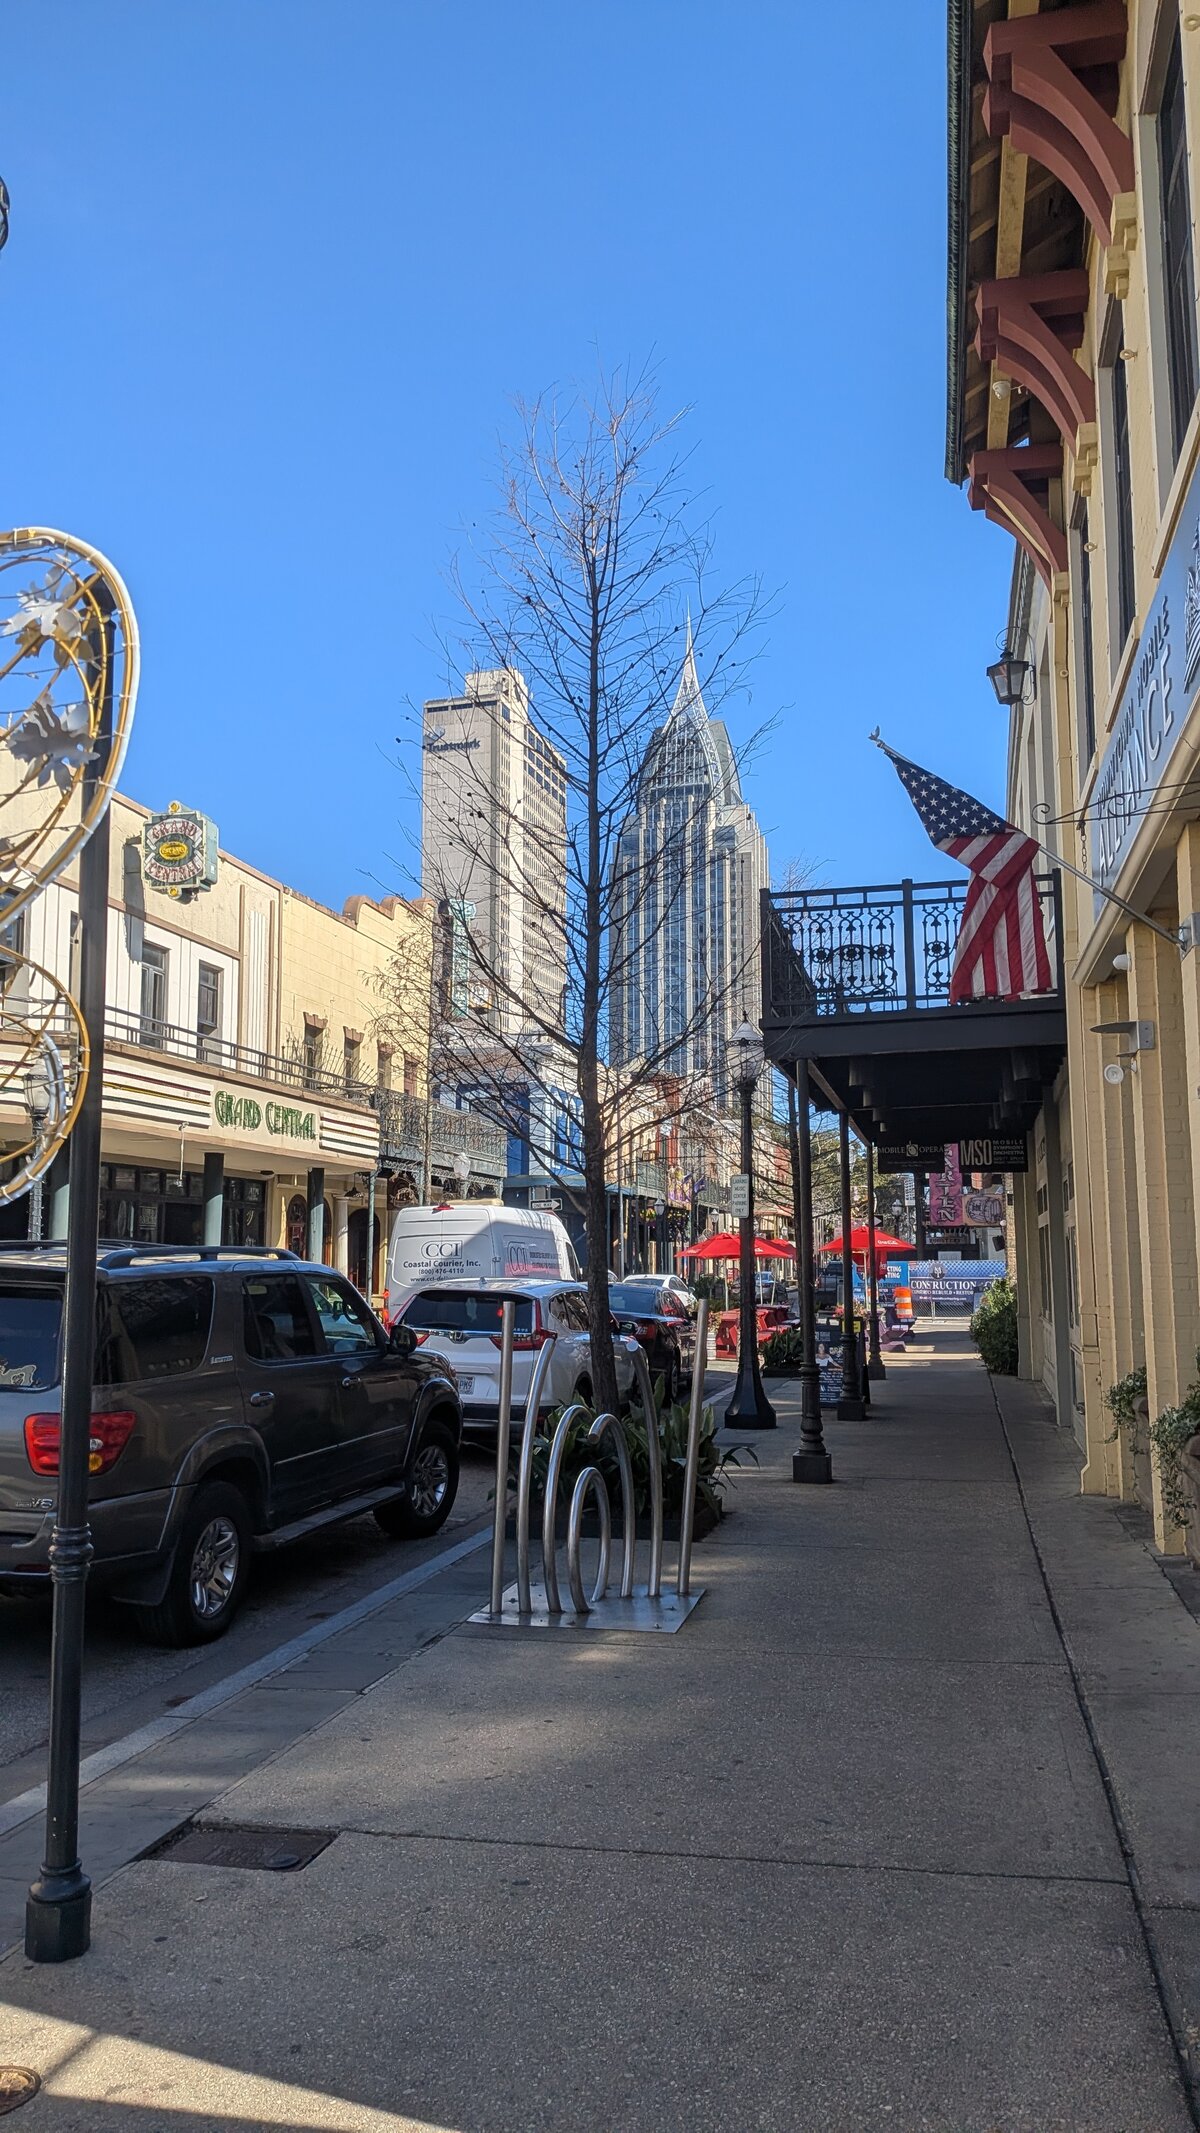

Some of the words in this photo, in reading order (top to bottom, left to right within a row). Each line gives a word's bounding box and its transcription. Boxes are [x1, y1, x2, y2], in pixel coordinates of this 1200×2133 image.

[1098, 698, 1135, 820] DOWNTOWN
[1137, 596, 1170, 707] MOBILE
[427, 738, 480, 752] Trustmark
[1099, 643, 1175, 888] ALLIANCE
[152, 820, 198, 840] GRAND
[148, 859, 201, 882] CENTRAL
[214, 1090, 262, 1132] GRAND
[265, 1101, 318, 1141] CENTRAL
[877, 1146, 906, 1154] MOBILE
[960, 1139, 992, 1166] MSO
[425, 1242, 461, 1258] CCI
[509, 1246, 527, 1272] CCI
[403, 1260, 432, 1268] Coastal
[433, 1260, 465, 1268] Courier,
[910, 1280, 977, 1290] CONSRUCTION
